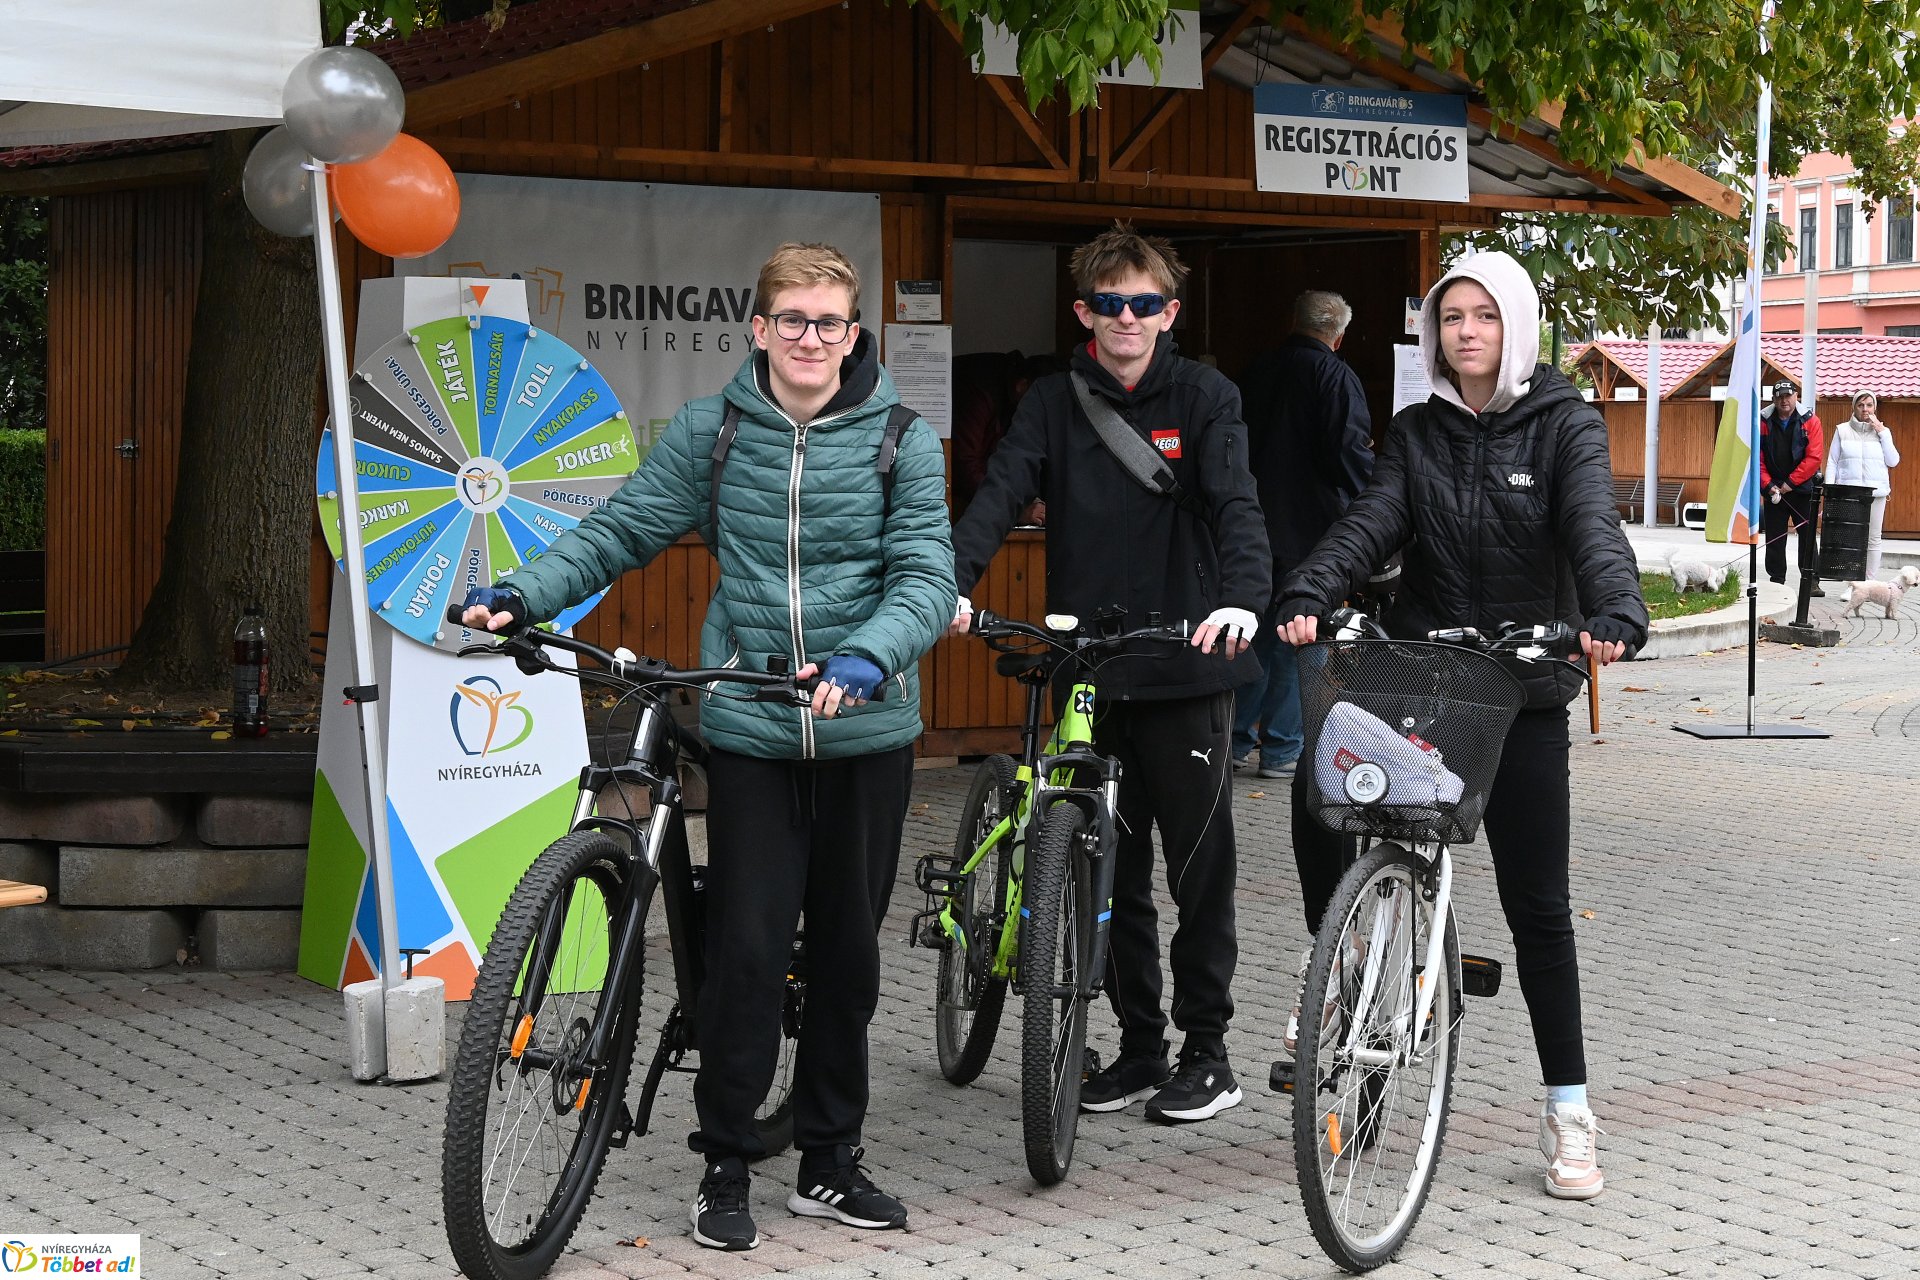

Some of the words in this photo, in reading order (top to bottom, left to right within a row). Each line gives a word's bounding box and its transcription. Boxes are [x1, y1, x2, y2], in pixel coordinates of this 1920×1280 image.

[1348, 95, 1413, 110] BRINGAVÁROS
[1348, 107, 1413, 117] NYÍREGYHÁZA
[1265, 124, 1458, 162] REGISZTRÁCIÓS
[584, 283, 758, 323] BRINGAV
[384, 356, 412, 389] ÚJRA!
[436, 339, 469, 404] JÁTÉK
[483, 331, 505, 417] TORNAZSÁK
[516, 363, 555, 409] TOLL
[360, 410, 390, 432] NYERT
[407, 387, 448, 436] PÖRGESS
[533, 388, 600, 447] NYAKPASS
[388, 427, 410, 444] NEM
[408, 439, 443, 464] SAJNOS
[554, 442, 615, 474] JOKER
[542, 487, 595, 507] PÖRGESS
[533, 513, 566, 537] NAPS
[404, 552, 452, 618] POHÁR
[465, 549, 482, 595] PÖRGE
[438, 761, 542, 781] NYÍREGYHÁZA
